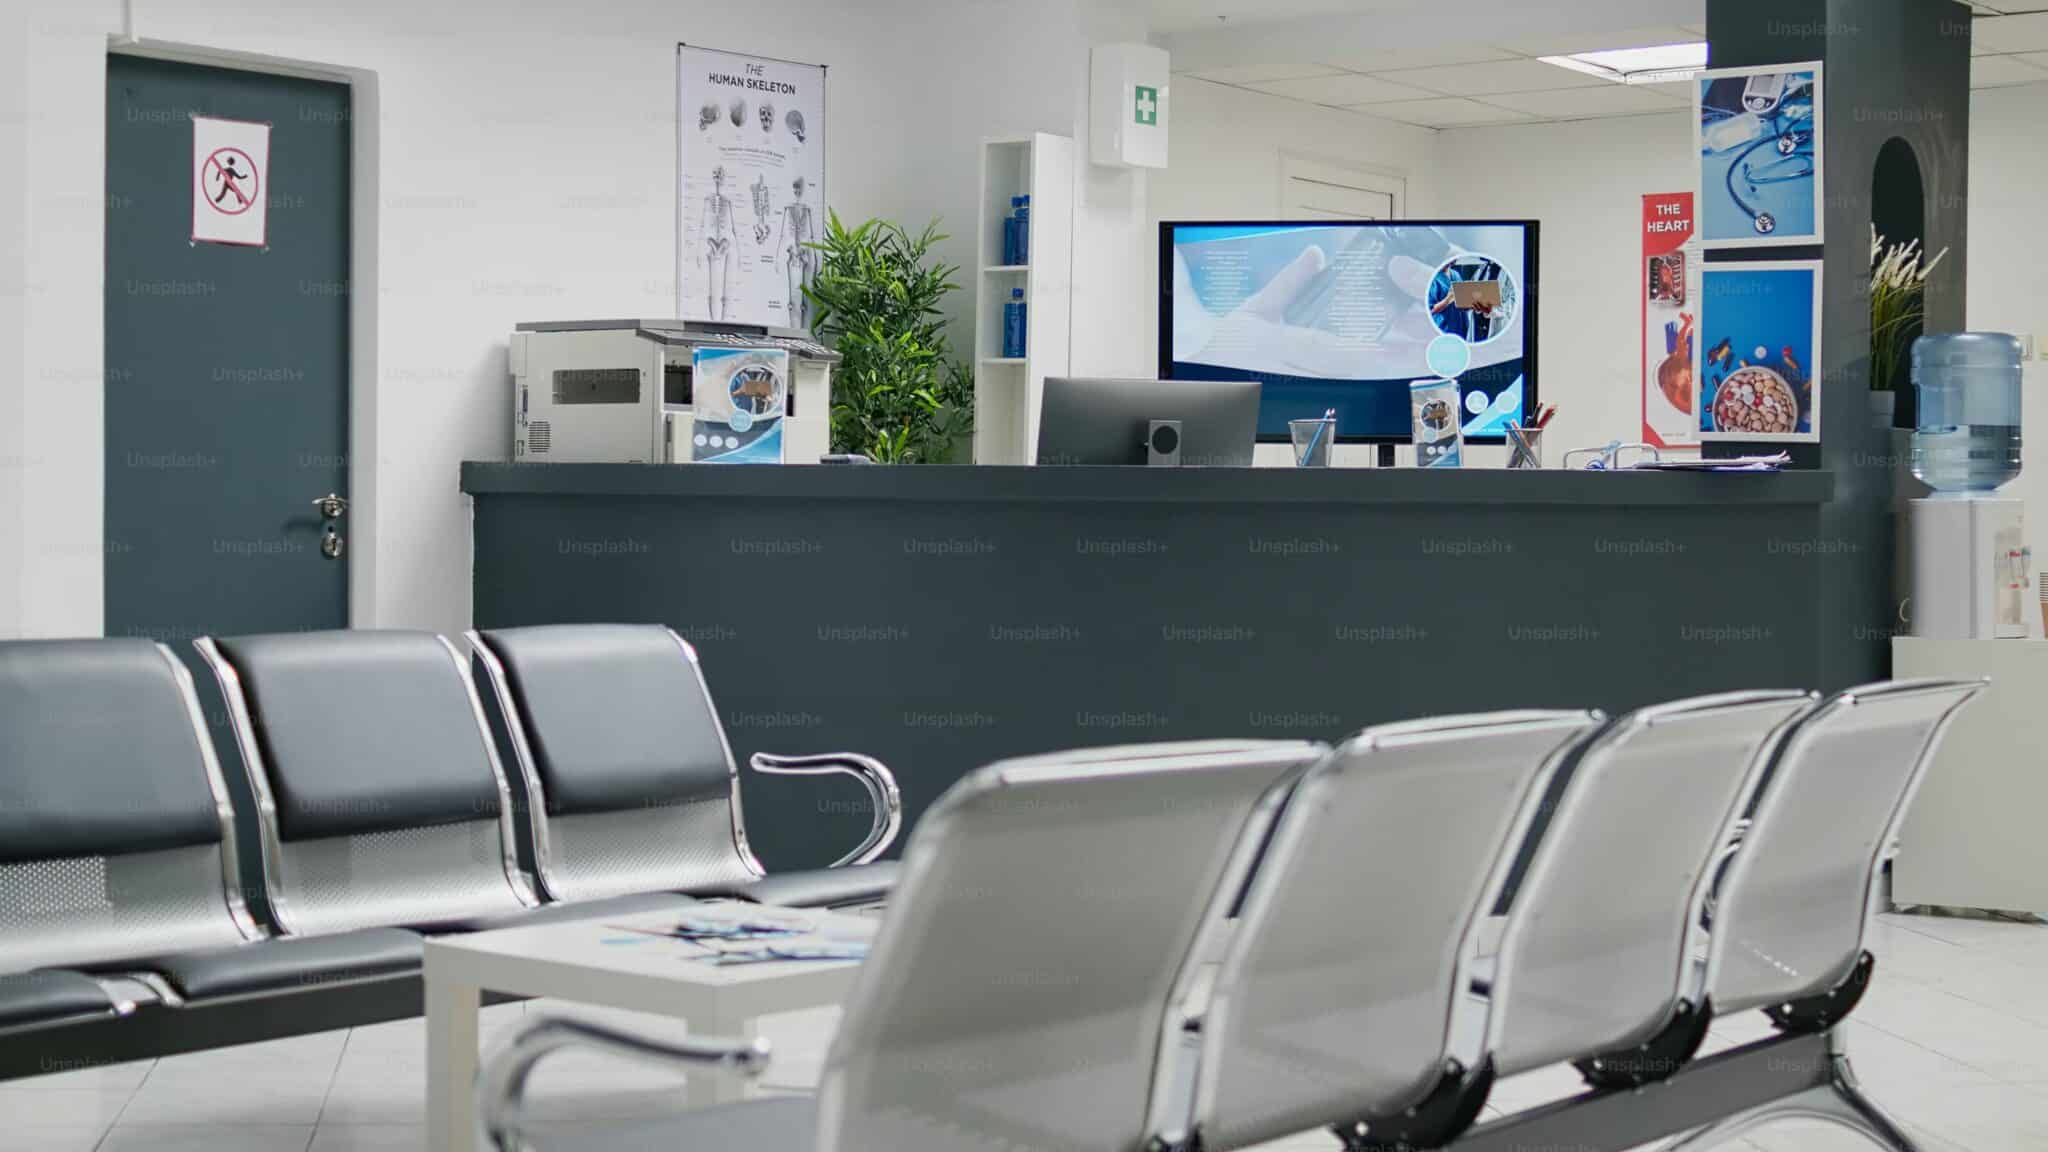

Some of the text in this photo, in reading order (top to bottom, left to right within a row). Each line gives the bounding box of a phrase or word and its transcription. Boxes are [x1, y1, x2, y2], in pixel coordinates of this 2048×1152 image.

[745, 63, 764, 76] THE
[708, 72, 796, 95] HUMAN SKELETON
[1656, 203, 1680, 215] THE
[1647, 219, 1689, 232] HEART
